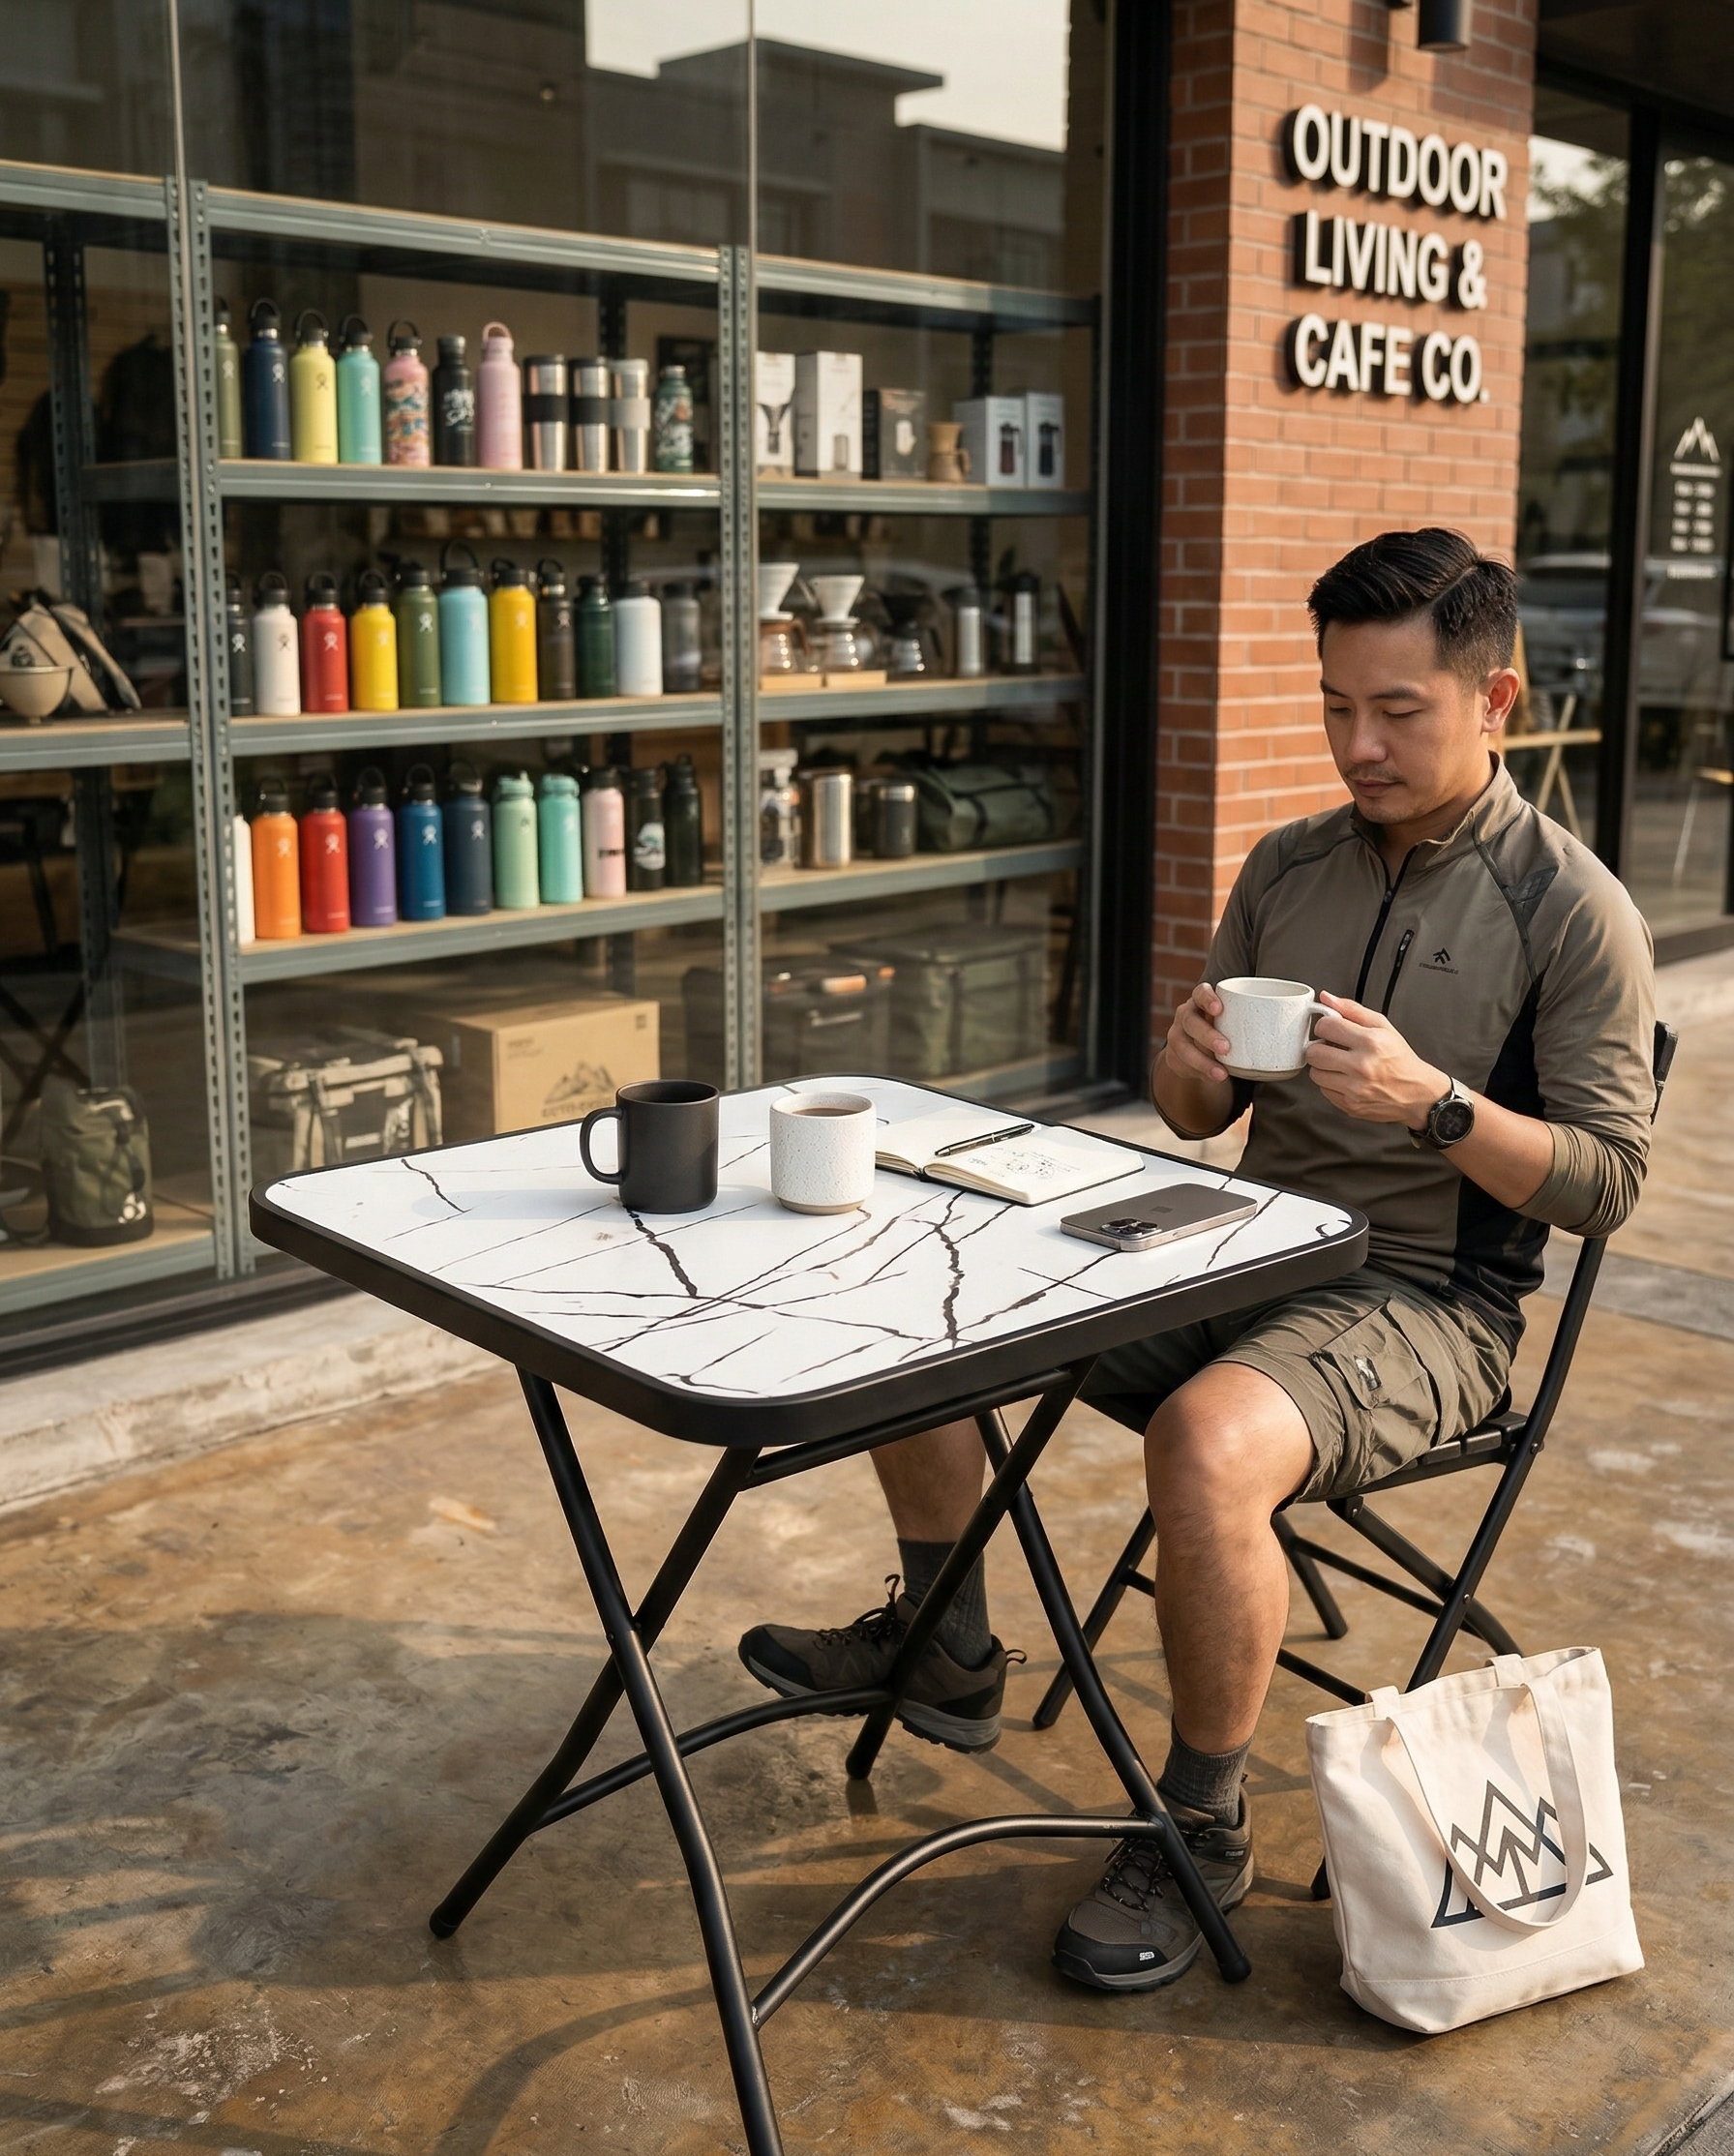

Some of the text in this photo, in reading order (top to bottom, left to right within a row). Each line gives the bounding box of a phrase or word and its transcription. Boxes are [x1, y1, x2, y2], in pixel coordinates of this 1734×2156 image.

[1293, 104, 1509, 221] OUTDOOR
[1304, 209, 1488, 311] LIVING &
[1294, 313, 1490, 404] CAFE CO.
